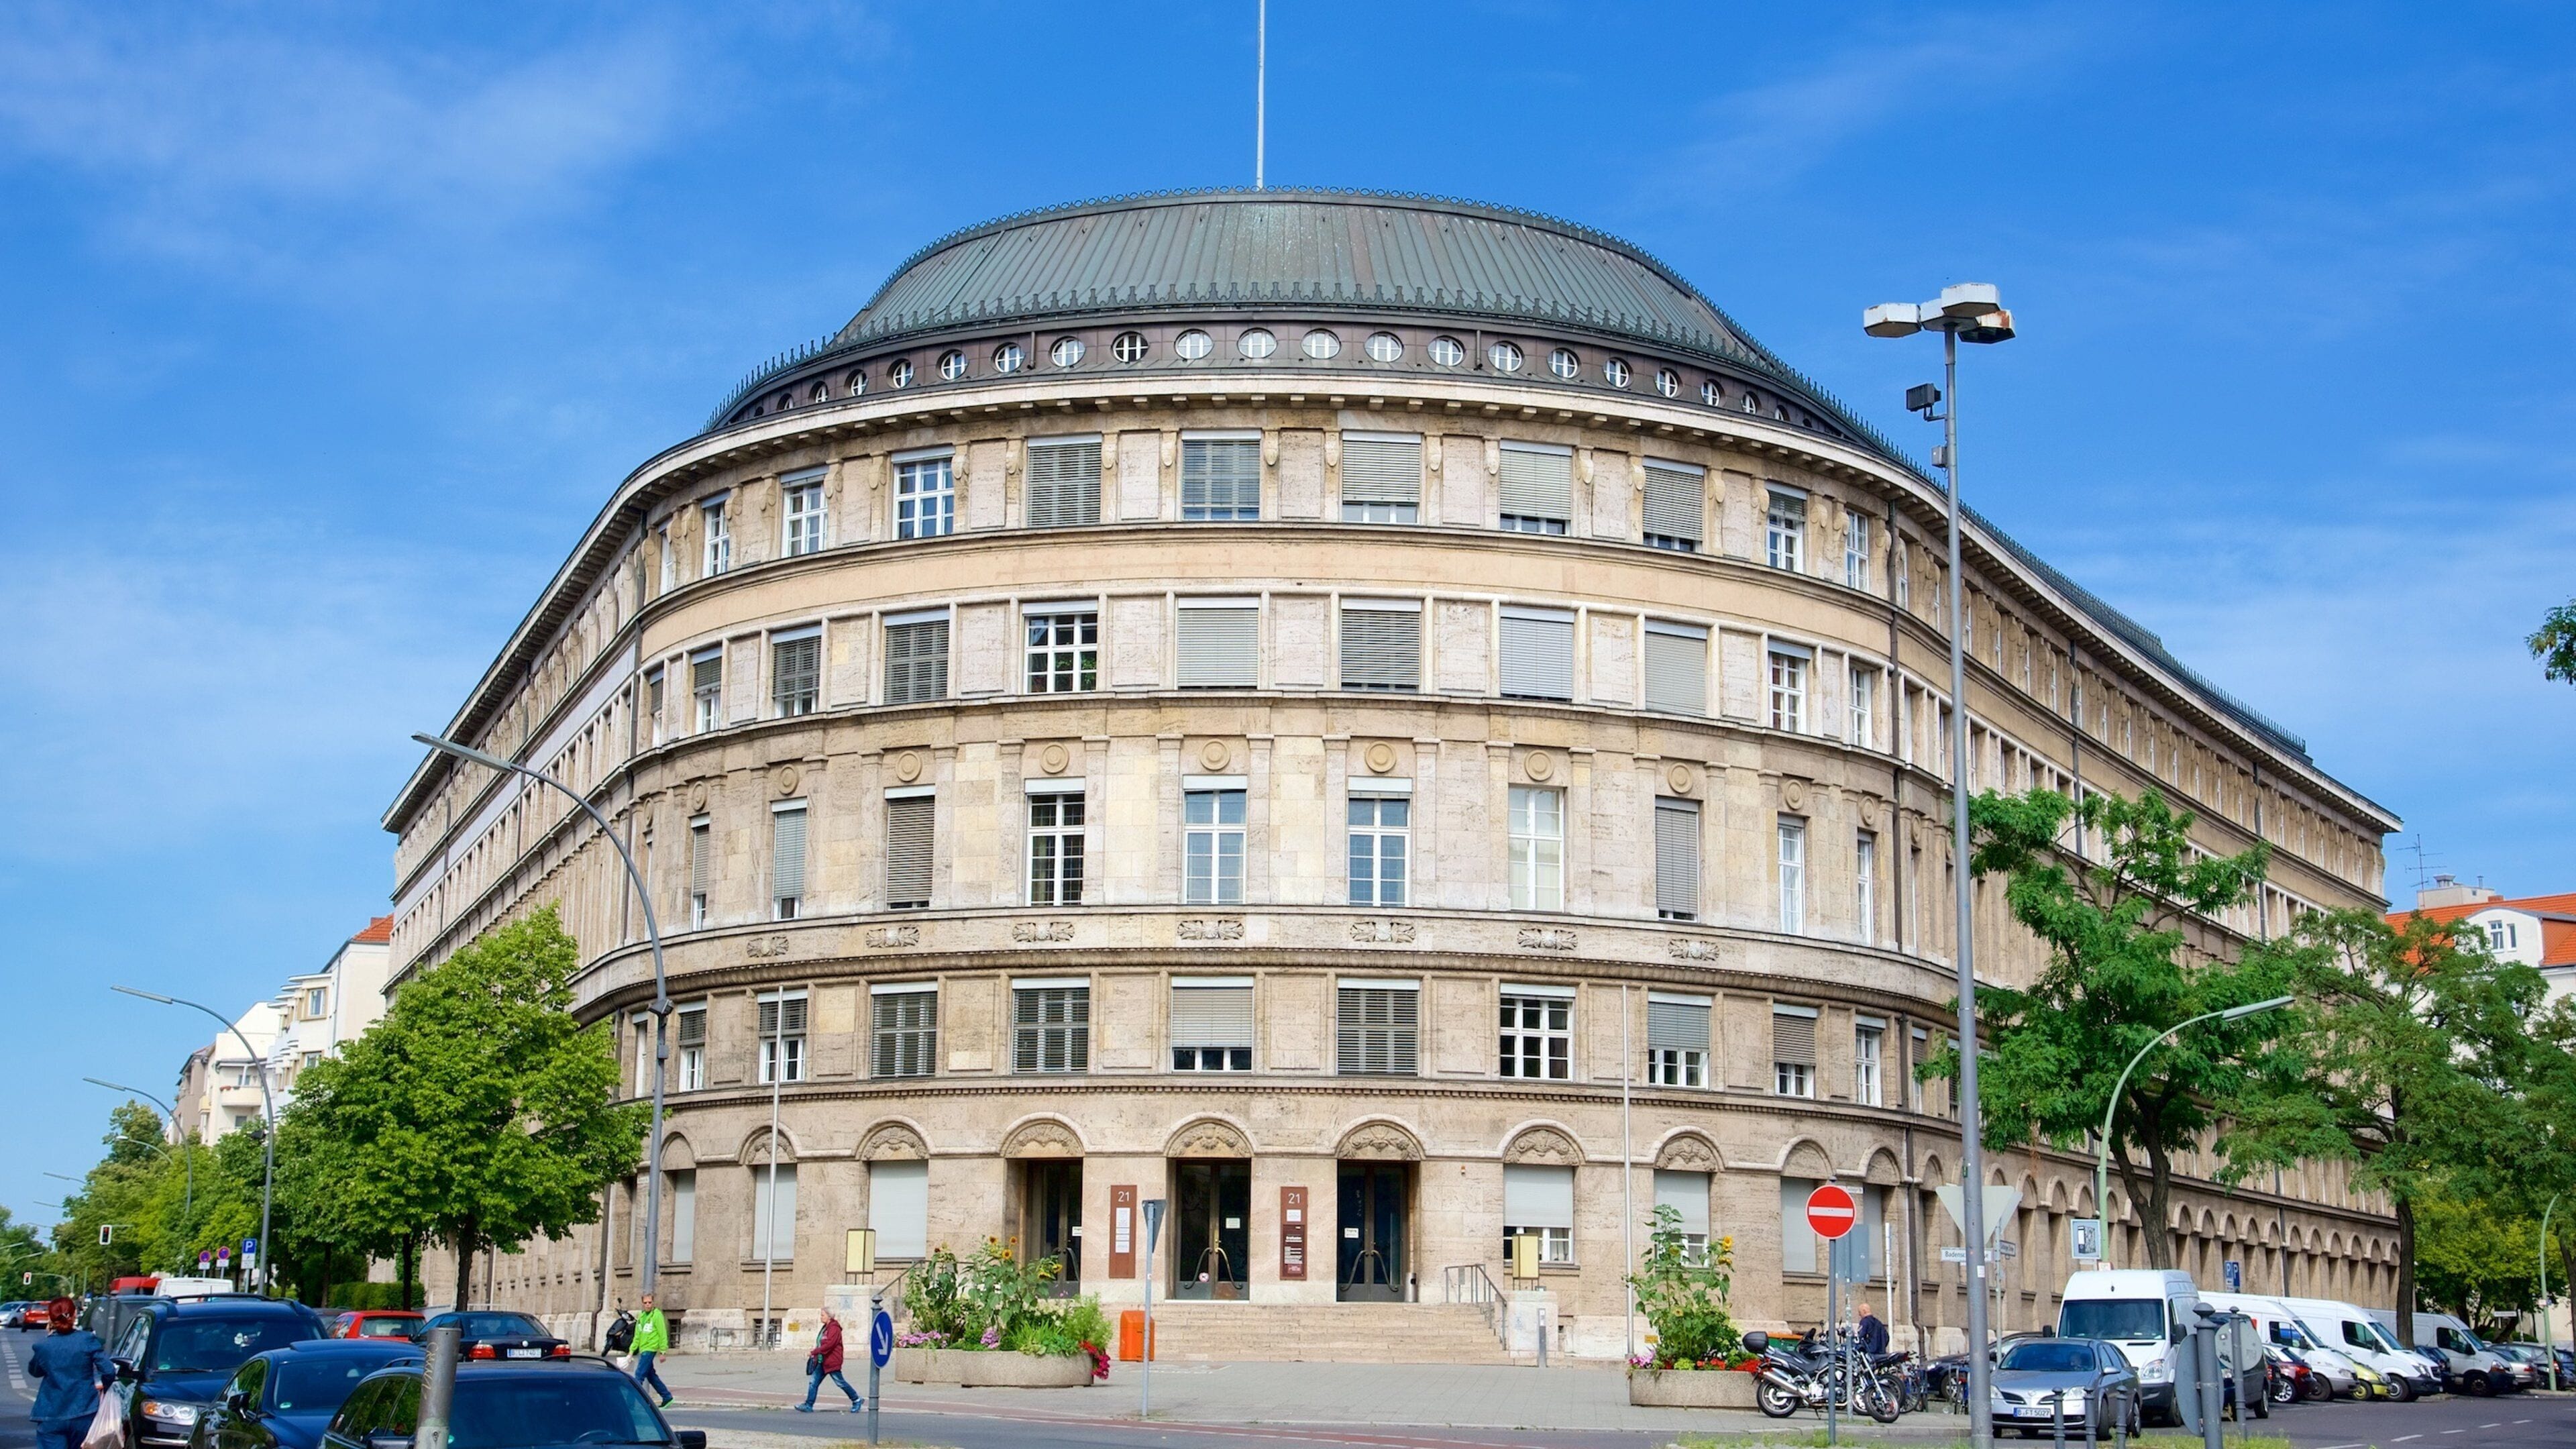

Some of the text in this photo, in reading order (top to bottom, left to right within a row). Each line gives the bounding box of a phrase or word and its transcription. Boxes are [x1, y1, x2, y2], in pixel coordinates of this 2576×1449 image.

[1118, 1191, 1130, 1202] 21
[1288, 1193, 1300, 1204] 21
[245, 1240, 253, 1252] P
[2226, 1263, 2231, 1276] P
[2233, 1264, 2239, 1279] P
